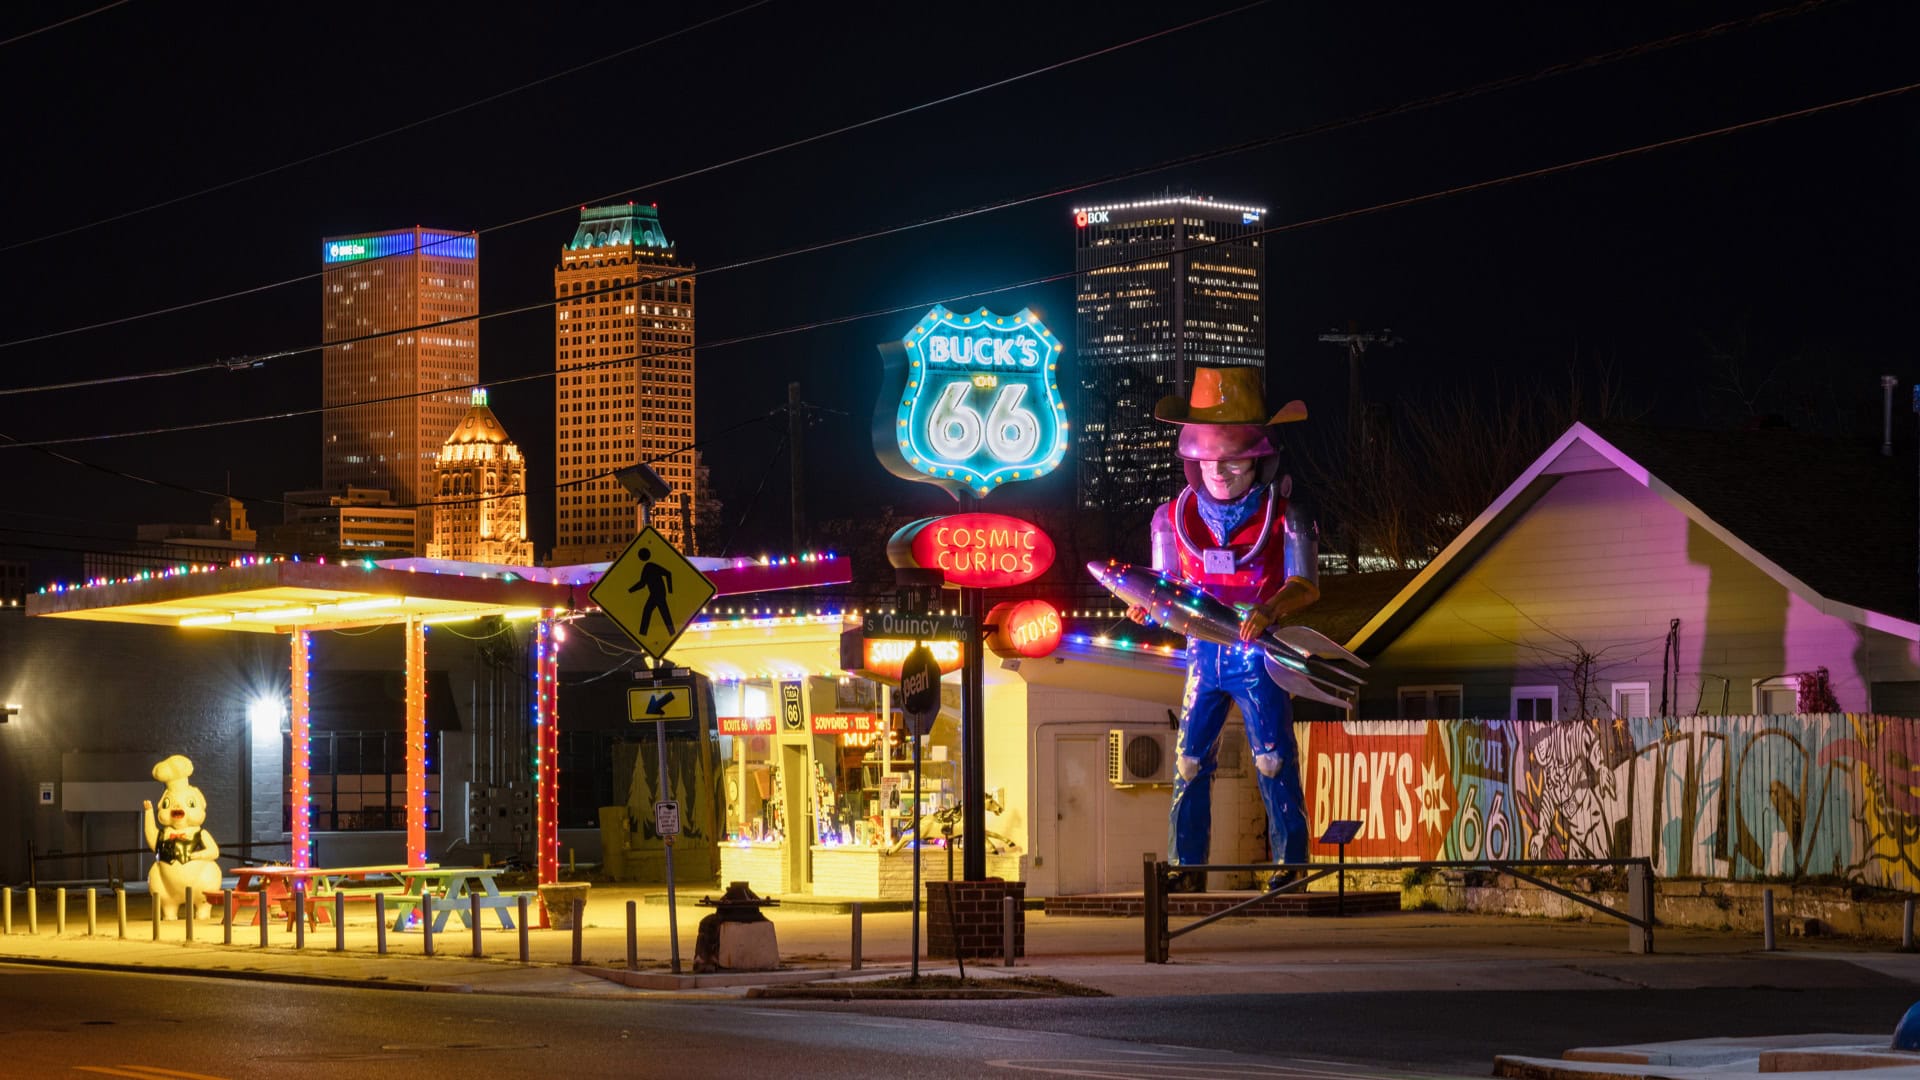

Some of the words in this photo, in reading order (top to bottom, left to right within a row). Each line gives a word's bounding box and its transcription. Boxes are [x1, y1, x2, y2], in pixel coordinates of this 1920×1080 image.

[1088, 211, 1109, 223] BOK
[929, 335, 1039, 366] BUCK'S
[974, 376, 997, 388] ON
[927, 382, 1040, 462] 66
[937, 527, 1036, 550] COSMIC
[938, 551, 1033, 574] CURIOS
[867, 620, 874, 631] S
[883, 614, 939, 638] Quincy
[952, 618, 965, 629] Av
[1017, 613, 1058, 644] TOYS
[903, 664, 929, 704] pearl
[787, 704, 799, 722] 66
[855, 717, 870, 730] TEES
[723, 719, 740, 732] ROUTE
[741, 719, 749, 731] 66
[1465, 735, 1504, 773] ROUTE
[1314, 751, 1413, 843] BUCK'S
[1424, 787, 1440, 810] ON
[1458, 786, 1511, 861] 66
